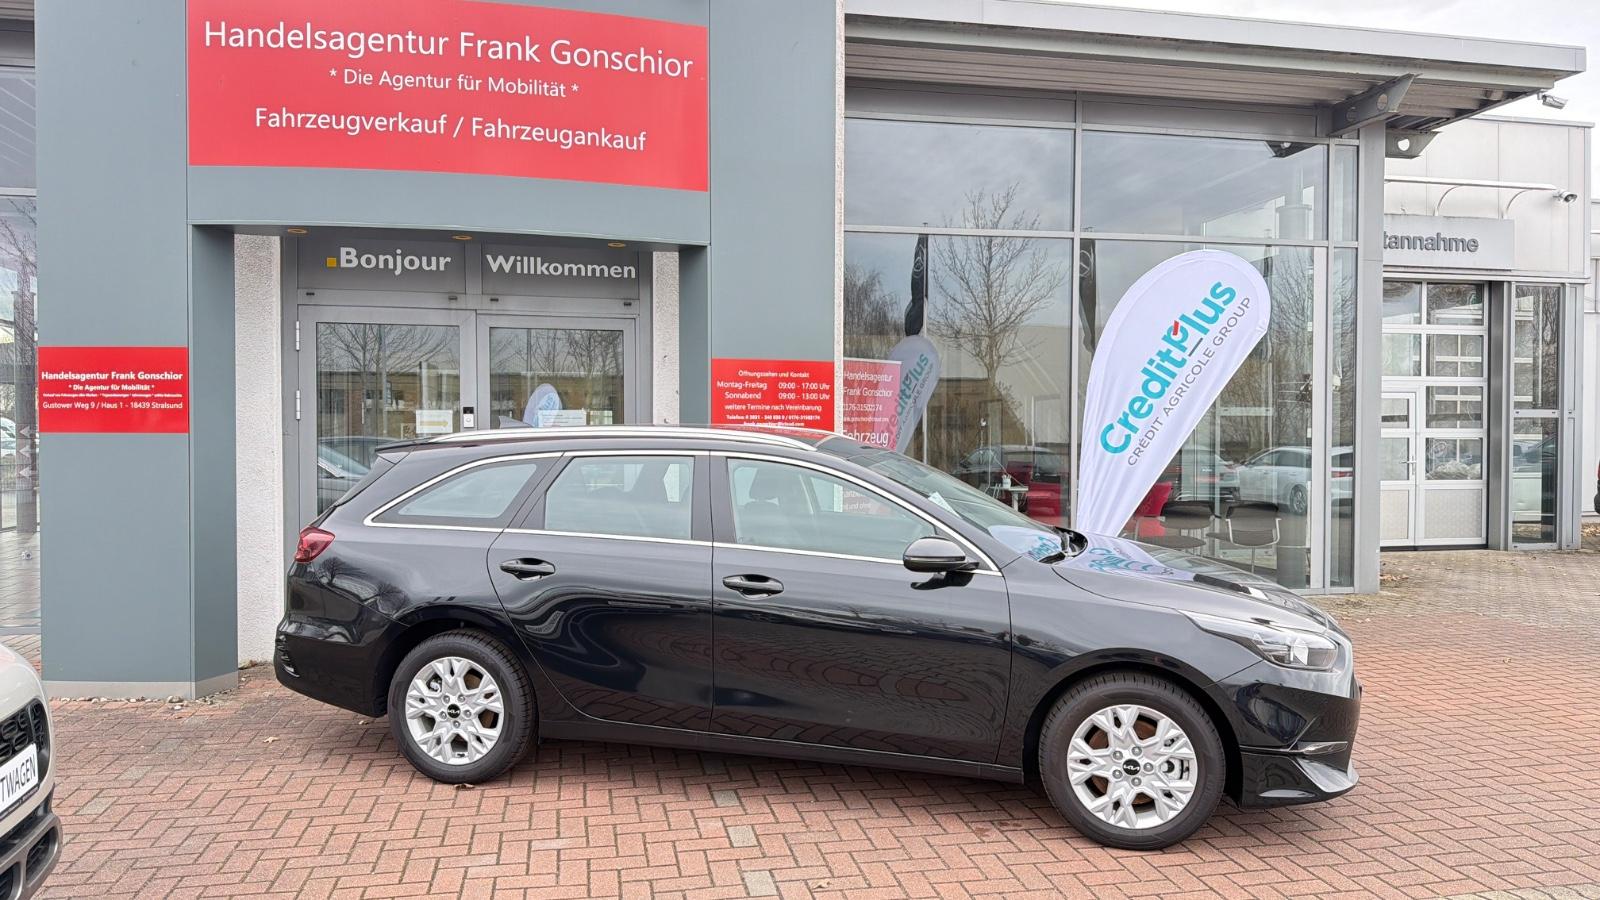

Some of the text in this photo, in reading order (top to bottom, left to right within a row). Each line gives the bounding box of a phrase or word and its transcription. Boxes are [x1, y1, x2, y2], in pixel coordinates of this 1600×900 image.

[205, 21, 693, 78] Handelsagentur Frank Gonschior
[344, 68, 566, 97] Die Agentur für Mobilität
[255, 107, 646, 151] Fahrzeugverkauf / Fahrzeugankauf
[1383, 231, 1479, 253] tannahme
[340, 247, 451, 276] Bonjour
[487, 254, 636, 279] Willkommen
[41, 371, 183, 381] Handelsagentur Frank Gonschior
[843, 371, 893, 384] Handelsagentur
[1100, 282, 1236, 454] CreditPlus
[716, 380, 768, 390] Montag-Freitag
[843, 386, 895, 398] Frank Gonschior
[1127, 297, 1250, 466] CRÉDIT AGRICOLE GROUP
[74, 402, 89, 410] Weg
[724, 391, 762, 399] Sonnabend
